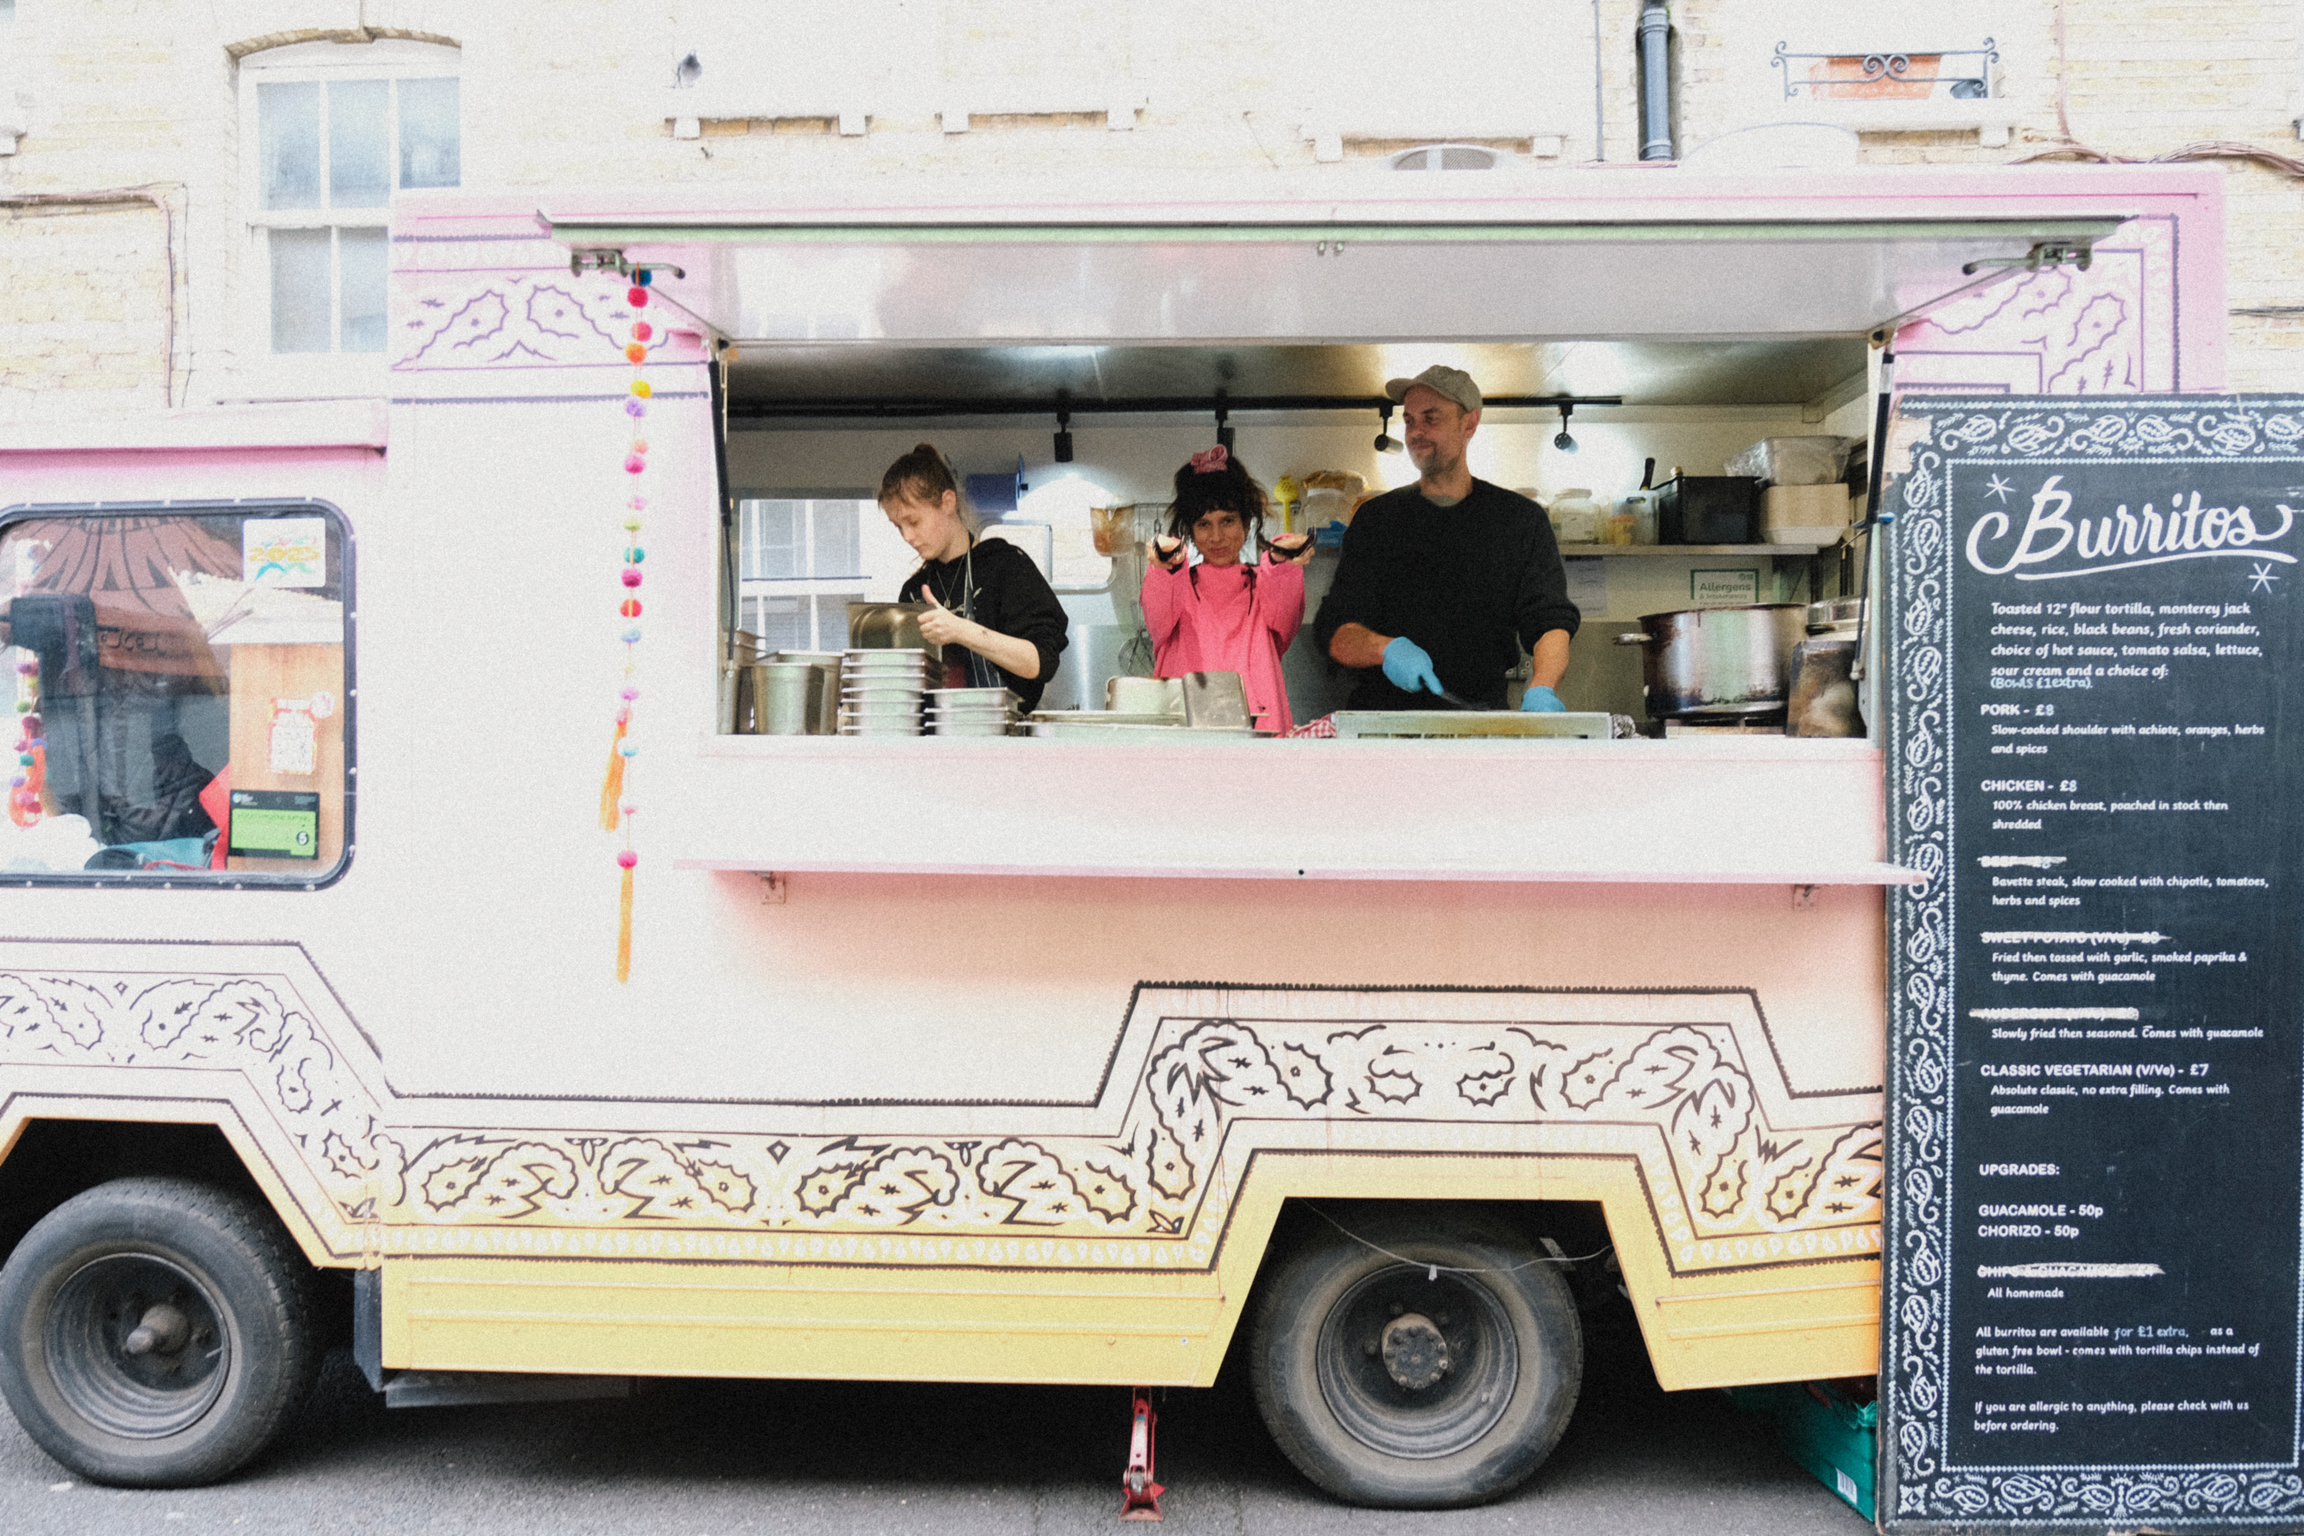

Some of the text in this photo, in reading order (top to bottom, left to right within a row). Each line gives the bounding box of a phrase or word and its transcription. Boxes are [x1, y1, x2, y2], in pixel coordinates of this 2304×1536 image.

[1965, 475, 2294, 575] Burritos
[249, 545, 320, 562] 2025
[1699, 582, 1751, 593] Allergens
[1991, 601, 2251, 619] Toasted 12" flour tortilla, monterey jack
[1990, 622, 2260, 639] cheese, rice, black beans, fresh coriander,
[1990, 642, 2263, 659] choice of hot sauce, tomato salsa, lettuce,
[1990, 663, 2169, 680] sour cream and a choice of:
[1980, 703, 2021, 716] PORK
[2035, 704, 2054, 717] £8
[1991, 723, 2265, 738] Slow-cooked shoulder with achiote, oranges, herbs
[1990, 742, 2048, 756] and spices
[1980, 779, 2045, 792] CHICKEN
[2060, 779, 2077, 793] £8
[1992, 799, 2229, 813] 100% chicken breast, poached in stock then
[1992, 818, 2042, 830] shredded
[297, 831, 308, 845] 5
[1992, 875, 2269, 889] Bavette steak, slow cooked with chipotle, tomatoes,
[1992, 894, 2081, 908] herbs and spices
[1991, 951, 2248, 966] Fried then tossed with garlic, smoked paprika &
[1991, 970, 2156, 985] thyme. Comes with guacamole
[1991, 1026, 2264, 1042] Slowly fried then seasoned. Comes with guacamole
[1980, 1064, 2041, 1077] CLASSIC
[2044, 1064, 2133, 1077] VEGETARIAN
[2135, 1064, 2175, 1078] (V/Ve)
[2190, 1063, 2209, 1076] £7
[1990, 1083, 2230, 1098] Absolute classic, no extra filling. Comes with
[1990, 1103, 2050, 1118] guacamole
[1979, 1163, 2060, 1176] UPGRADES:
[1978, 1204, 2066, 1217] GUACAMOLE
[2078, 1204, 2104, 1218] 50p
[1977, 1224, 2042, 1238] CHORIZO
[2054, 1224, 2080, 1239] 50p
[1987, 1287, 2064, 1298] All homemade
[1975, 1325, 2234, 1341] All burritos are available for £1 extra, as a
[1975, 1345, 2010, 1359] gluten
[2011, 1345, 2033, 1359] free
[2036, 1345, 2063, 1356] bowl
[2072, 1347, 2106, 1356] comes
[2108, 1344, 2133, 1356] with
[2135, 1344, 2174, 1355] tortilla
[2175, 1344, 2203, 1357] chips
[2205, 1343, 2246, 1355] instead
[2247, 1342, 2260, 1357] of
[1974, 1363, 2036, 1375] the tortilla.
[1974, 1399, 2249, 1415] If you are allergic to anything, please check with us
[1973, 1419, 2059, 1434] before ordering.
